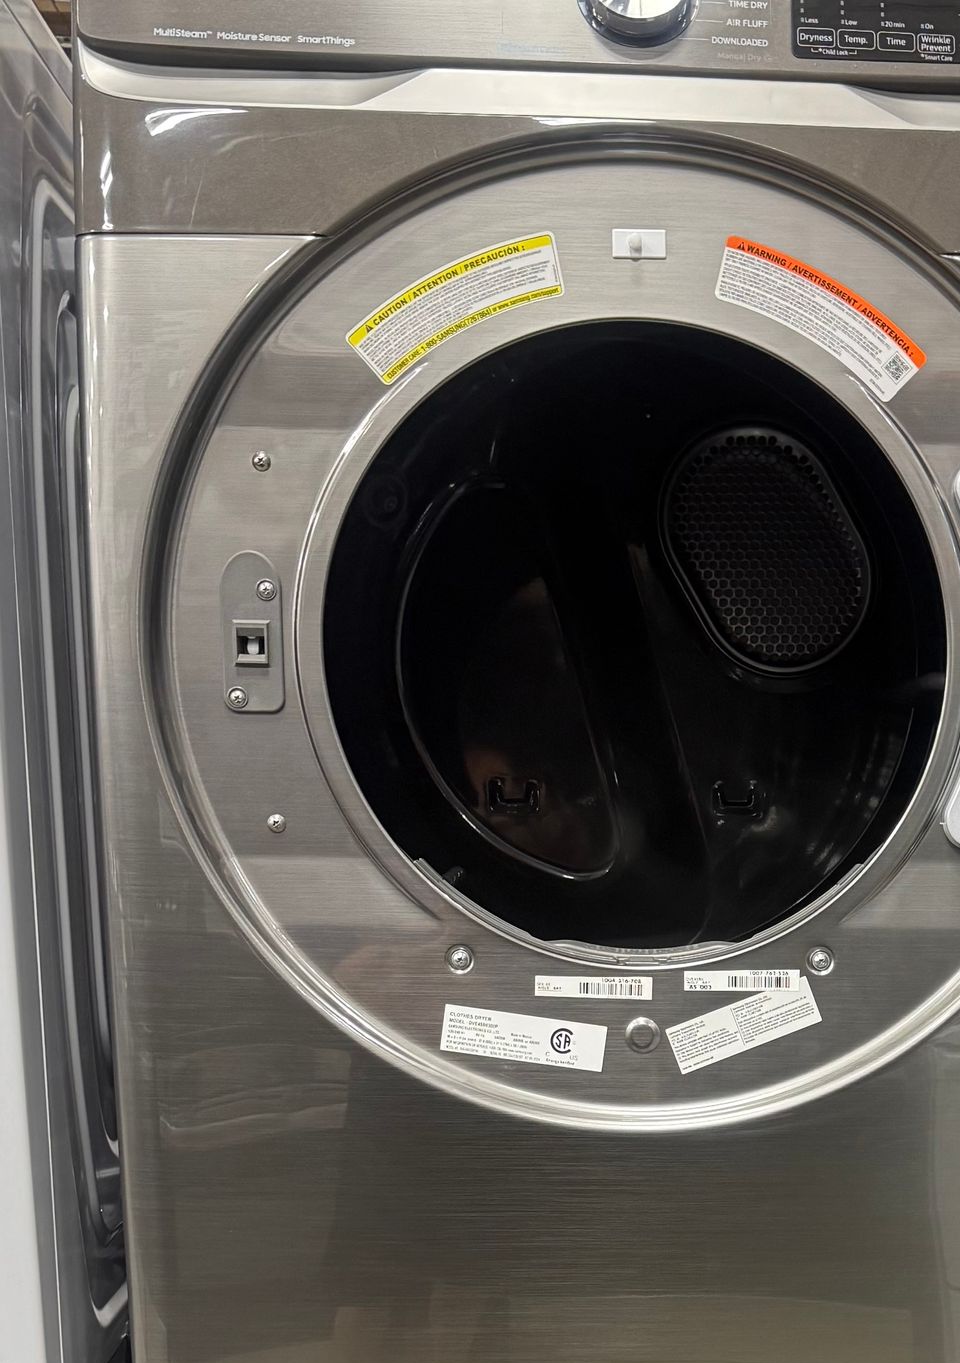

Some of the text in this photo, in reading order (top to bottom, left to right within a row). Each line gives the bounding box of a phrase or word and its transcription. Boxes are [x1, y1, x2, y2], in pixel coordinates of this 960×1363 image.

[729, 0, 768, 9] TIME DRY
[727, 18, 768, 28] AIR FLUFF
[217, 32, 258, 42] Moisture
[259, 33, 292, 42] Sensor
[297, 35, 356, 47] SmartThings
[711, 36, 768, 47] DOWNLOADED
[800, 32, 833, 43] Dryness
[844, 35, 868, 44] Temp.
[886, 37, 906, 46] Time
[920, 34, 951, 44] Wrinkle
[920, 43, 951, 53] Prevent
[373, 298, 408, 326] CAUTION
[412, 269, 459, 299] ATTENTION
[464, 245, 520, 271] PRECAUCIÓN
[746, 245, 787, 267] WARNING
[792, 265, 858, 307] AVERTISSEMENT
[861, 306, 910, 354] ADVERTENCIA
